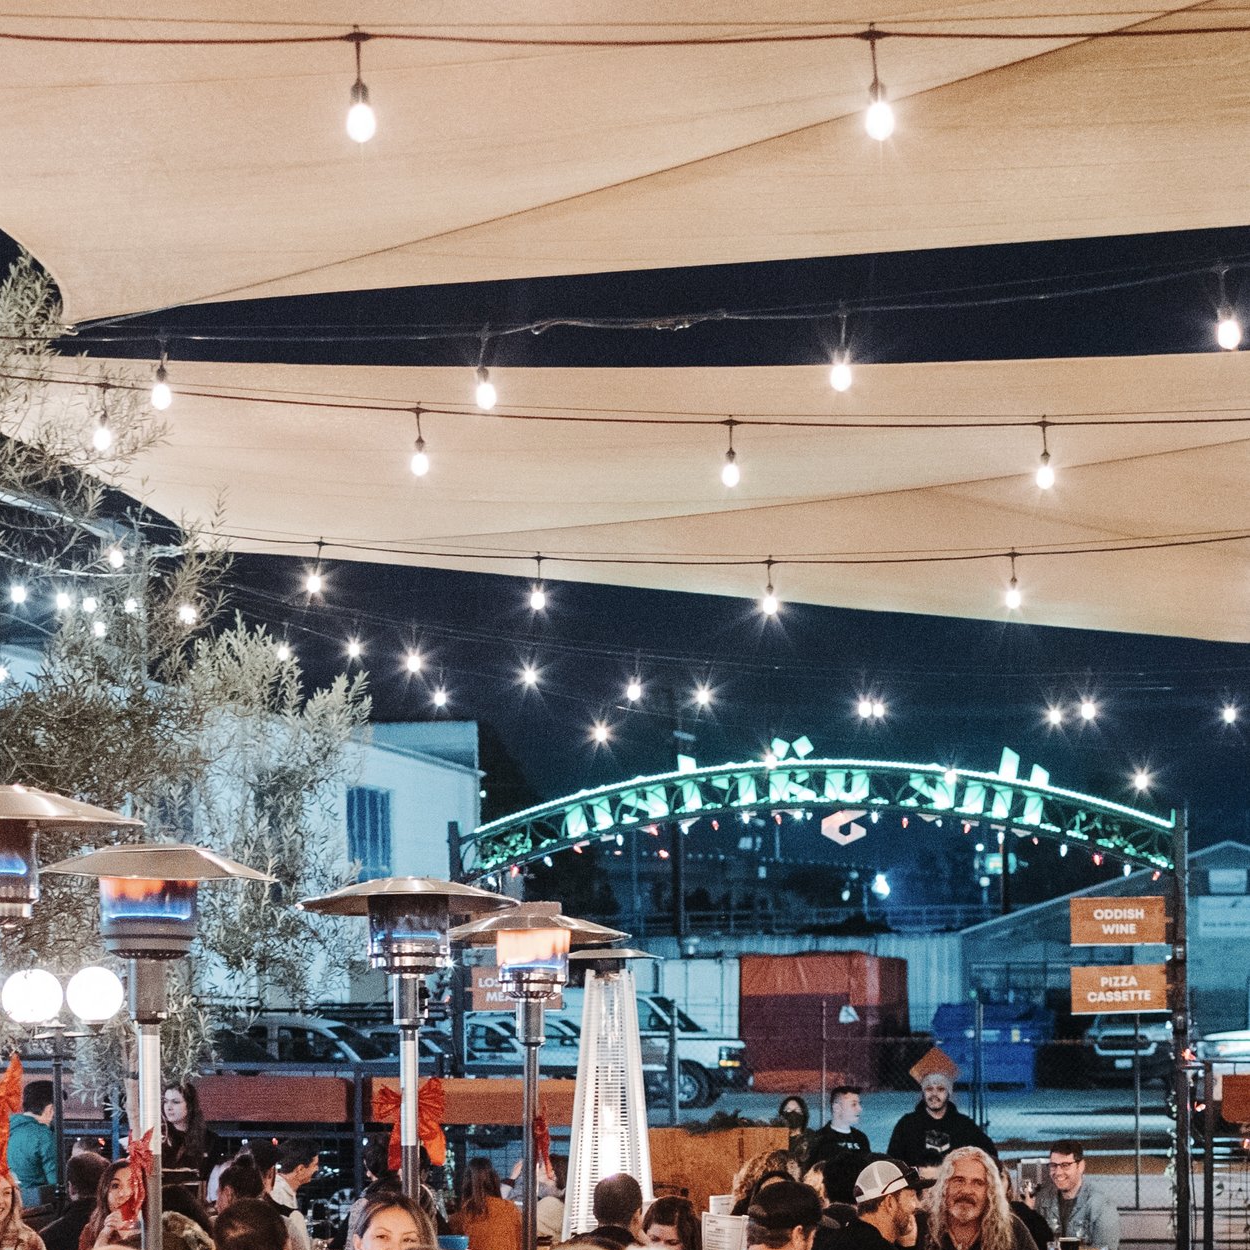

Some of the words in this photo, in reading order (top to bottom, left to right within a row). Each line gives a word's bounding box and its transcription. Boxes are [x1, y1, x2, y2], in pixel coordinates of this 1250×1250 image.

[1093, 908, 1145, 921] ODDISH
[1101, 923, 1137, 935] WINE
[1100, 975, 1139, 988] PIZZA
[1086, 989, 1152, 1003] CASSETTE
